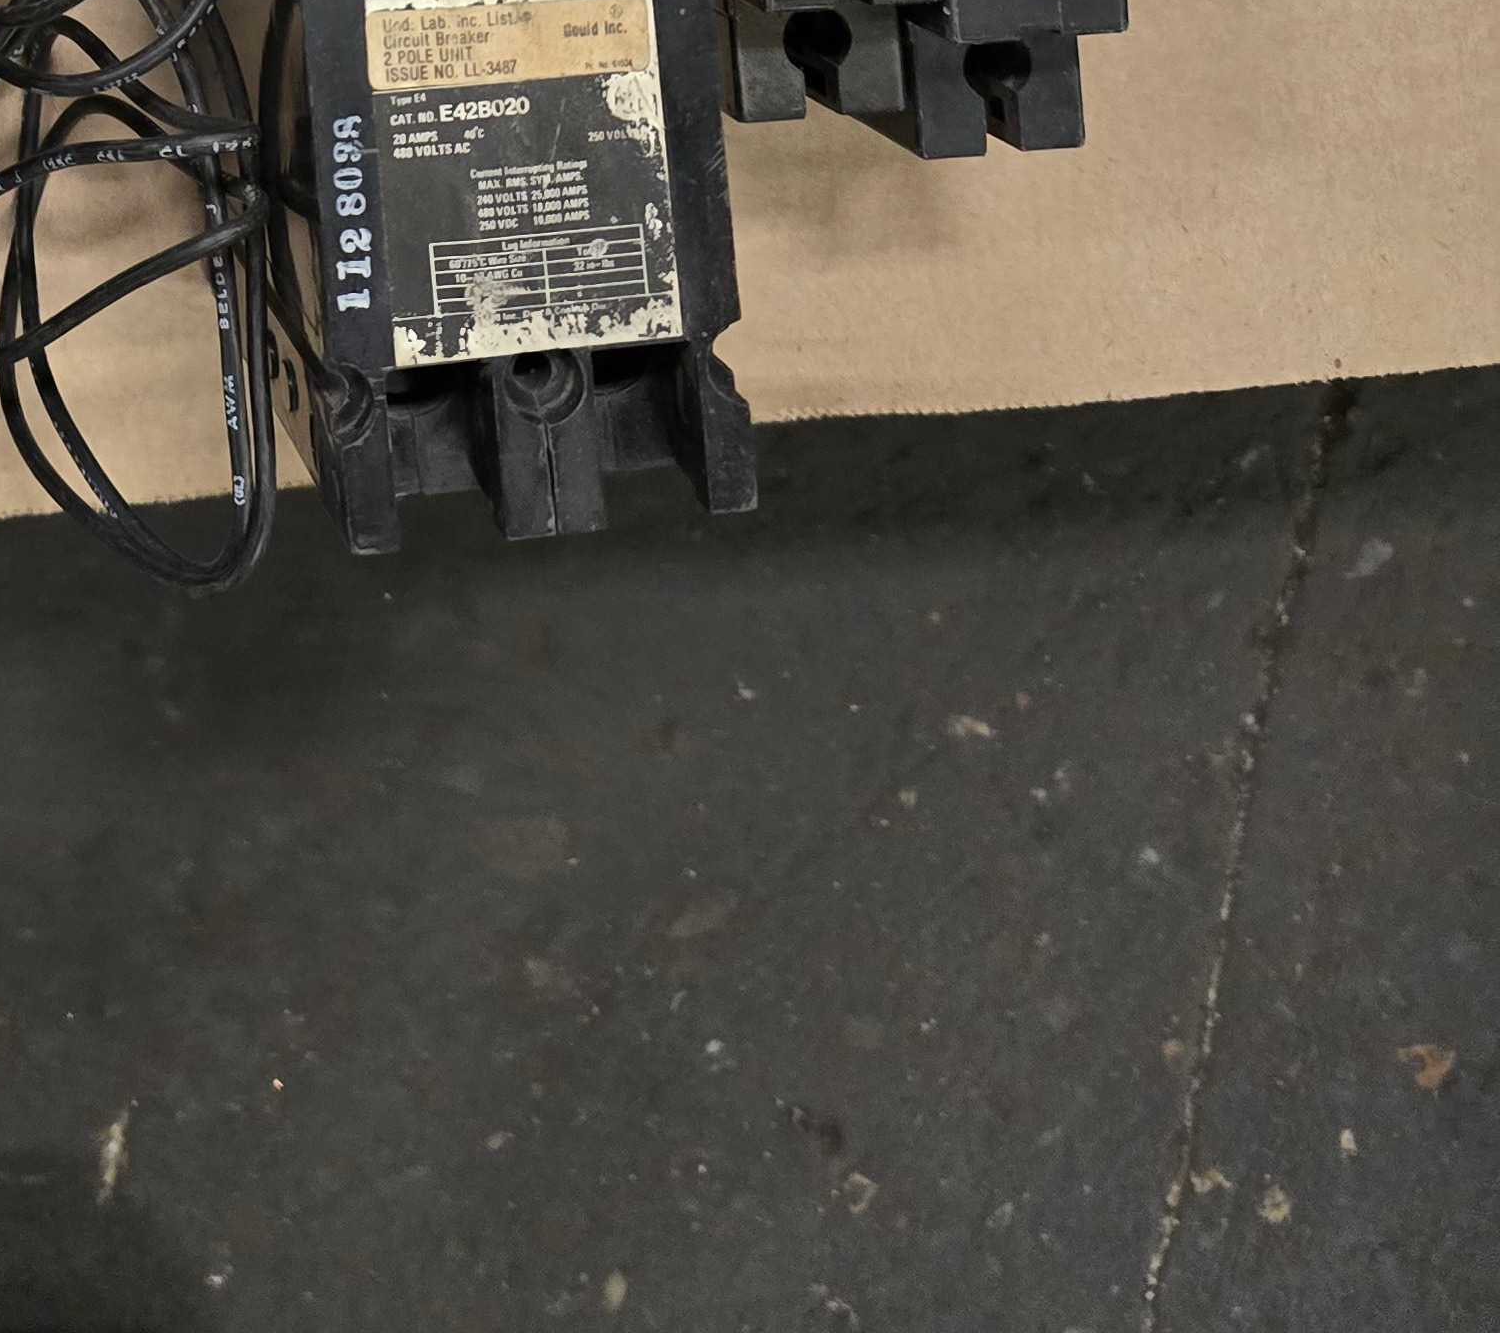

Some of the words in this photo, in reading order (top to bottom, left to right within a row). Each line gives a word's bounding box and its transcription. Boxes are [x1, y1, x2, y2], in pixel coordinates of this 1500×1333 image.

[384, 51, 392, 66] 2
[398, 50, 433, 65] POLE
[440, 46, 473, 61] UNIT
[386, 66, 428, 82] ISSUE
[434, 64, 457, 79] NO.
[464, 60, 517, 77] LL-3487
[439, 97, 530, 122] E42B020
[408, 131, 438, 144] AMPS
[415, 144, 454, 158] VOLTS
[454, 142, 471, 155] AC
[495, 191, 528, 203] VOLTS
[562, 185, 588, 196] AMPS
[496, 204, 529, 216] VOLTS
[563, 198, 589, 209] AMPS
[564, 210, 590, 222] AMPS
[226, 374, 238, 430] AWM
